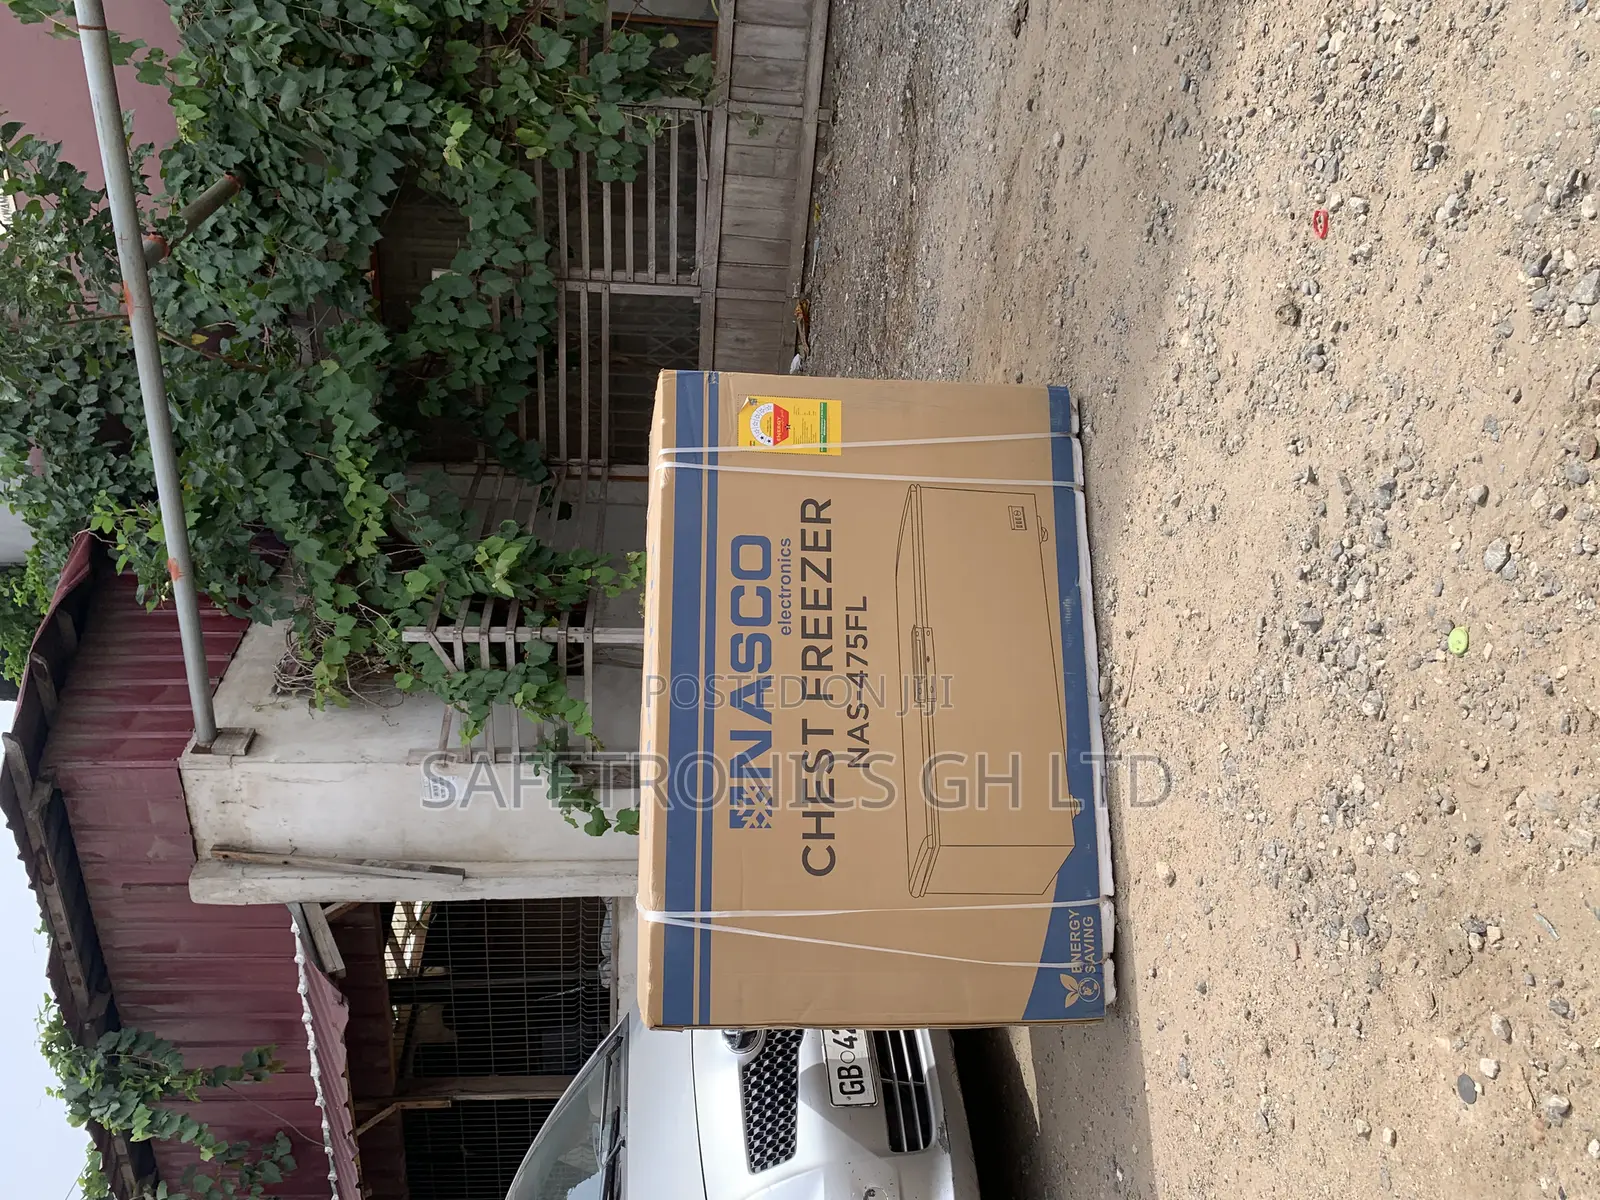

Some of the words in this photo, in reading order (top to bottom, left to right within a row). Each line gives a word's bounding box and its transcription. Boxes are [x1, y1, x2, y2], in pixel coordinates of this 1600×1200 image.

[777, 537, 792, 636] electronics
[800, 498, 834, 701] FREEZER
[730, 535, 772, 779] NASCO
[845, 596, 870, 769] NAS-475FL
[802, 718, 836, 877] CHEST
[1068, 909, 1082, 974] ENERGY
[1083, 916, 1096, 974] SAVING
[837, 1065, 865, 1095] GB
